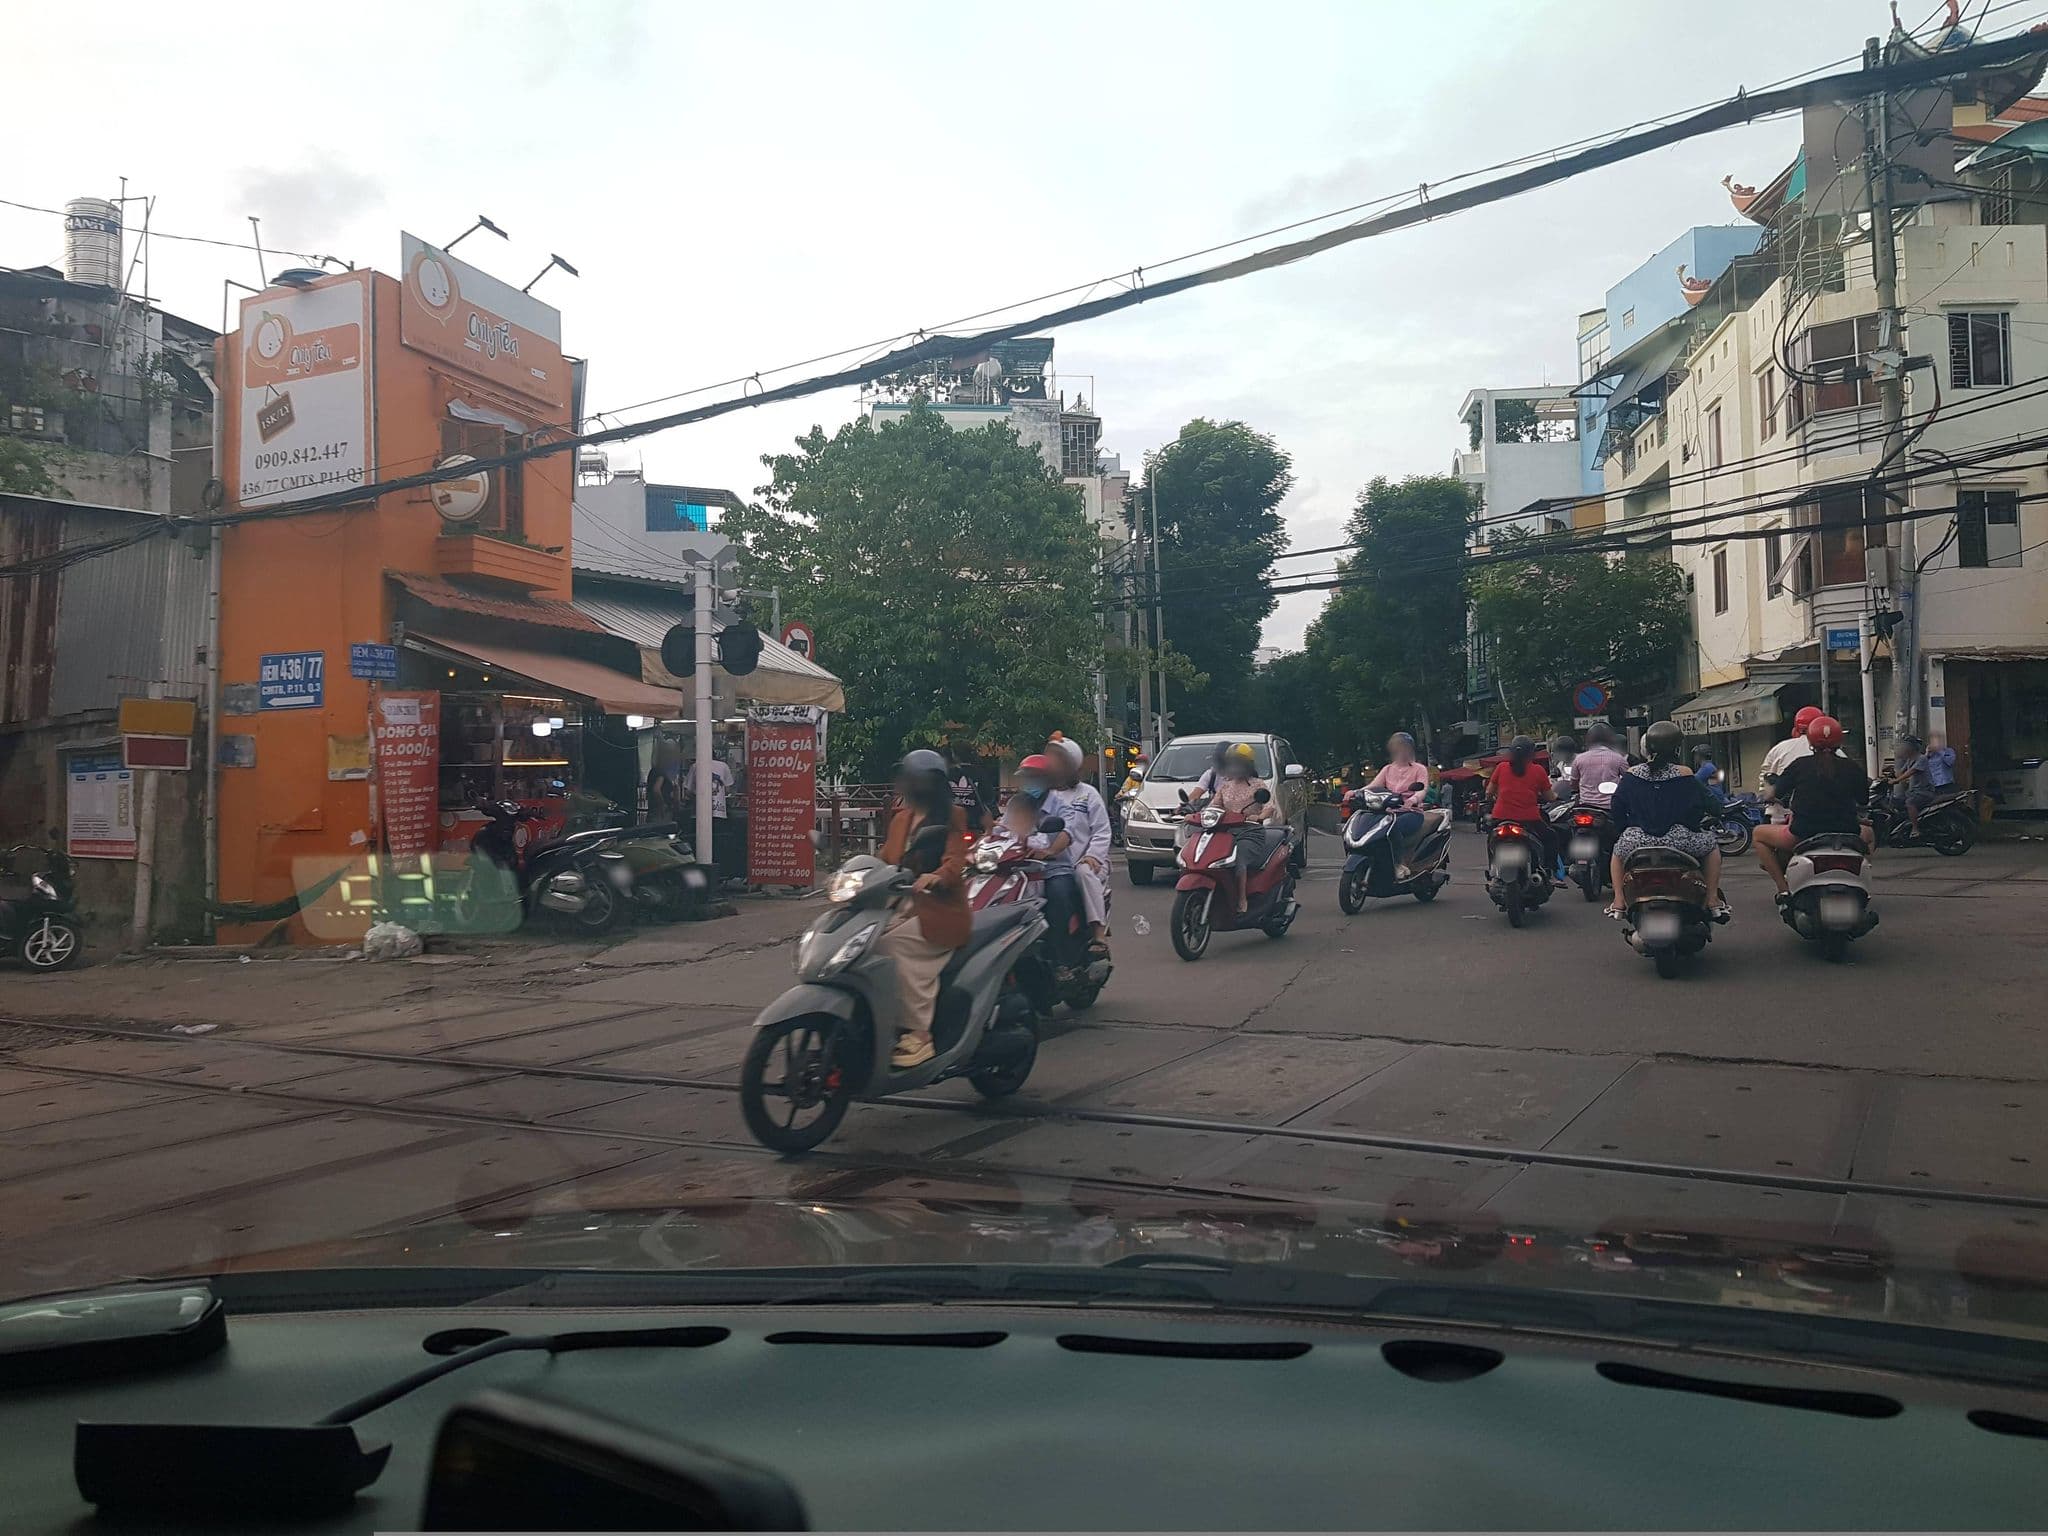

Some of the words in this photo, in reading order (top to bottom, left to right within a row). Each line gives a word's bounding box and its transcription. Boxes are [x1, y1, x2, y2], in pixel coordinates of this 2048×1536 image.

[255, 441, 348, 470] 0909.842.447
[241, 480, 279, 496] 436/77
[1710, 712, 1734, 729] BIA
[790, 736, 812, 751] GIÁ
